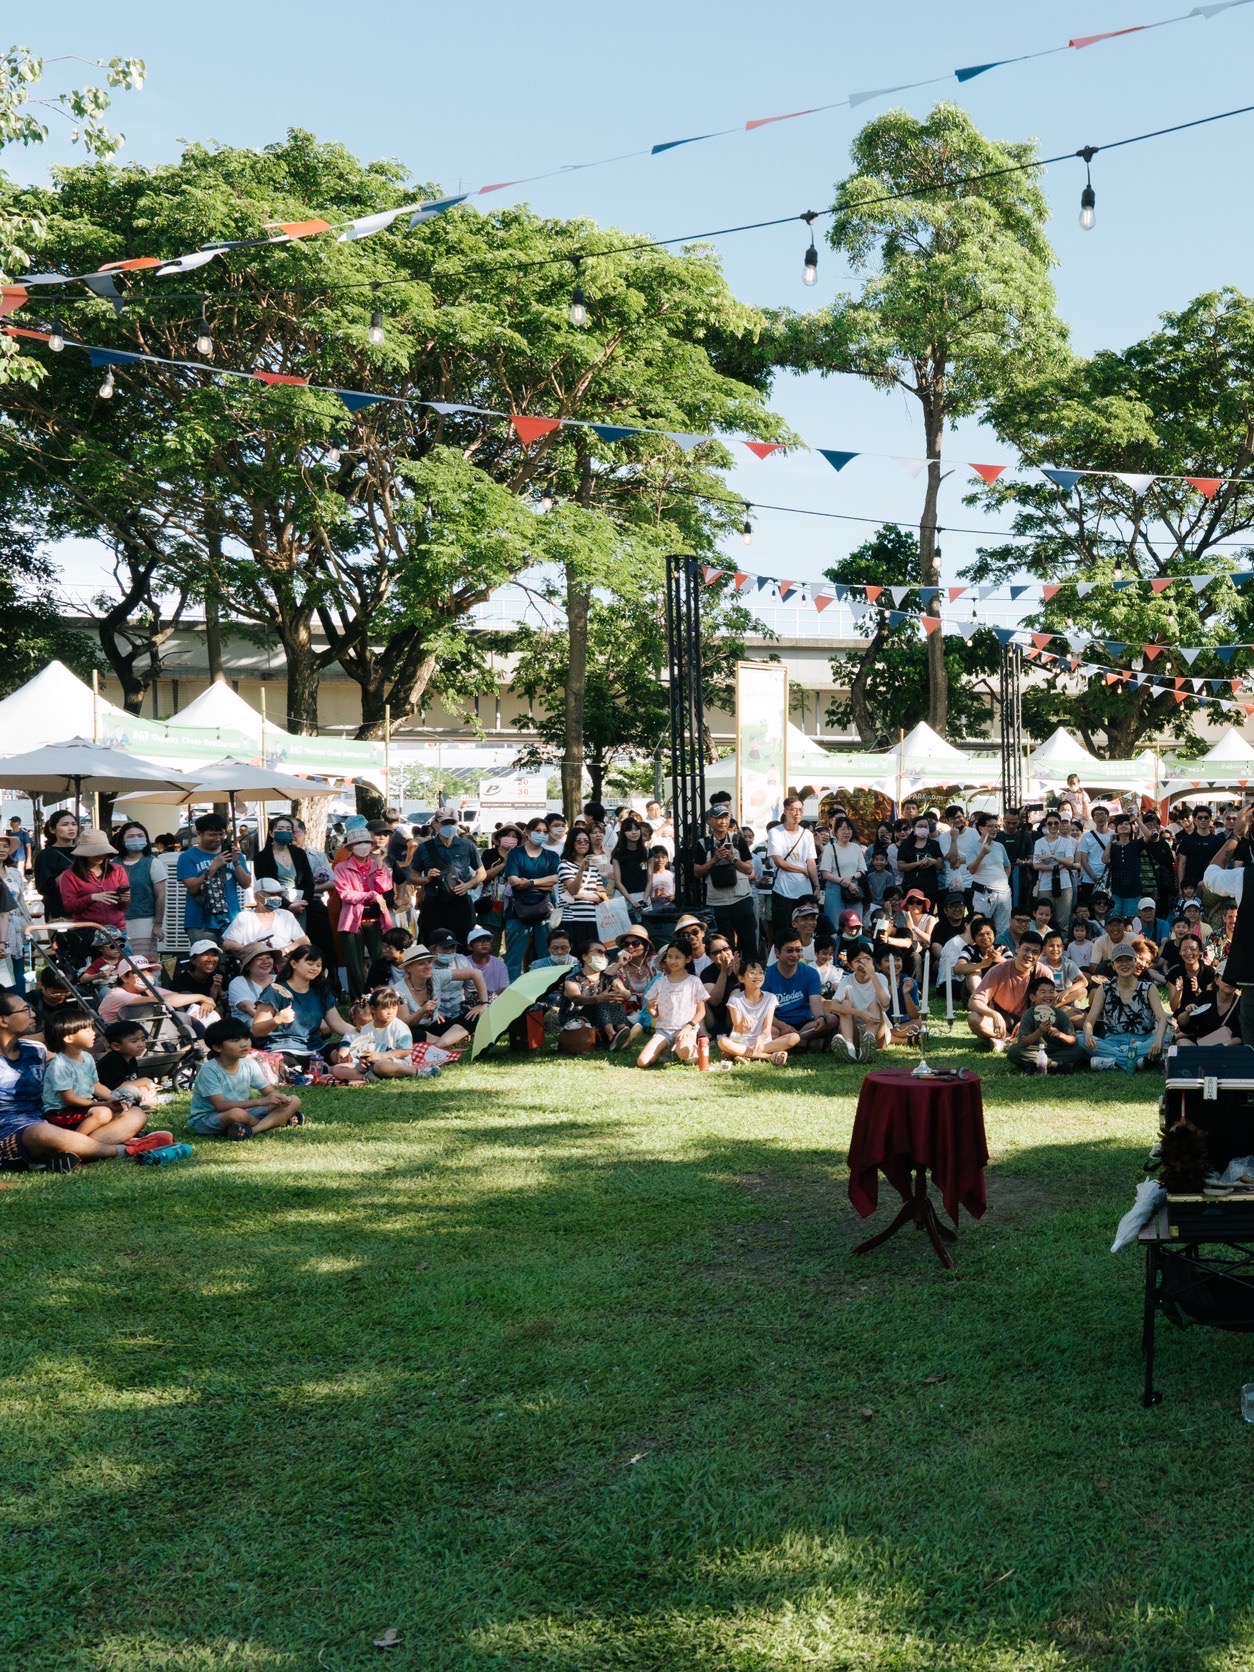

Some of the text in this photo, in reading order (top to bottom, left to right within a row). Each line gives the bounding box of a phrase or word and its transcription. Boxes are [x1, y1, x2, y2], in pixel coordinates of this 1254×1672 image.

[132, 730, 241, 749] #67 Thomas Chien Restaurant
[289, 745, 303, 755] #67
[776, 989, 805, 1005] Diodes
